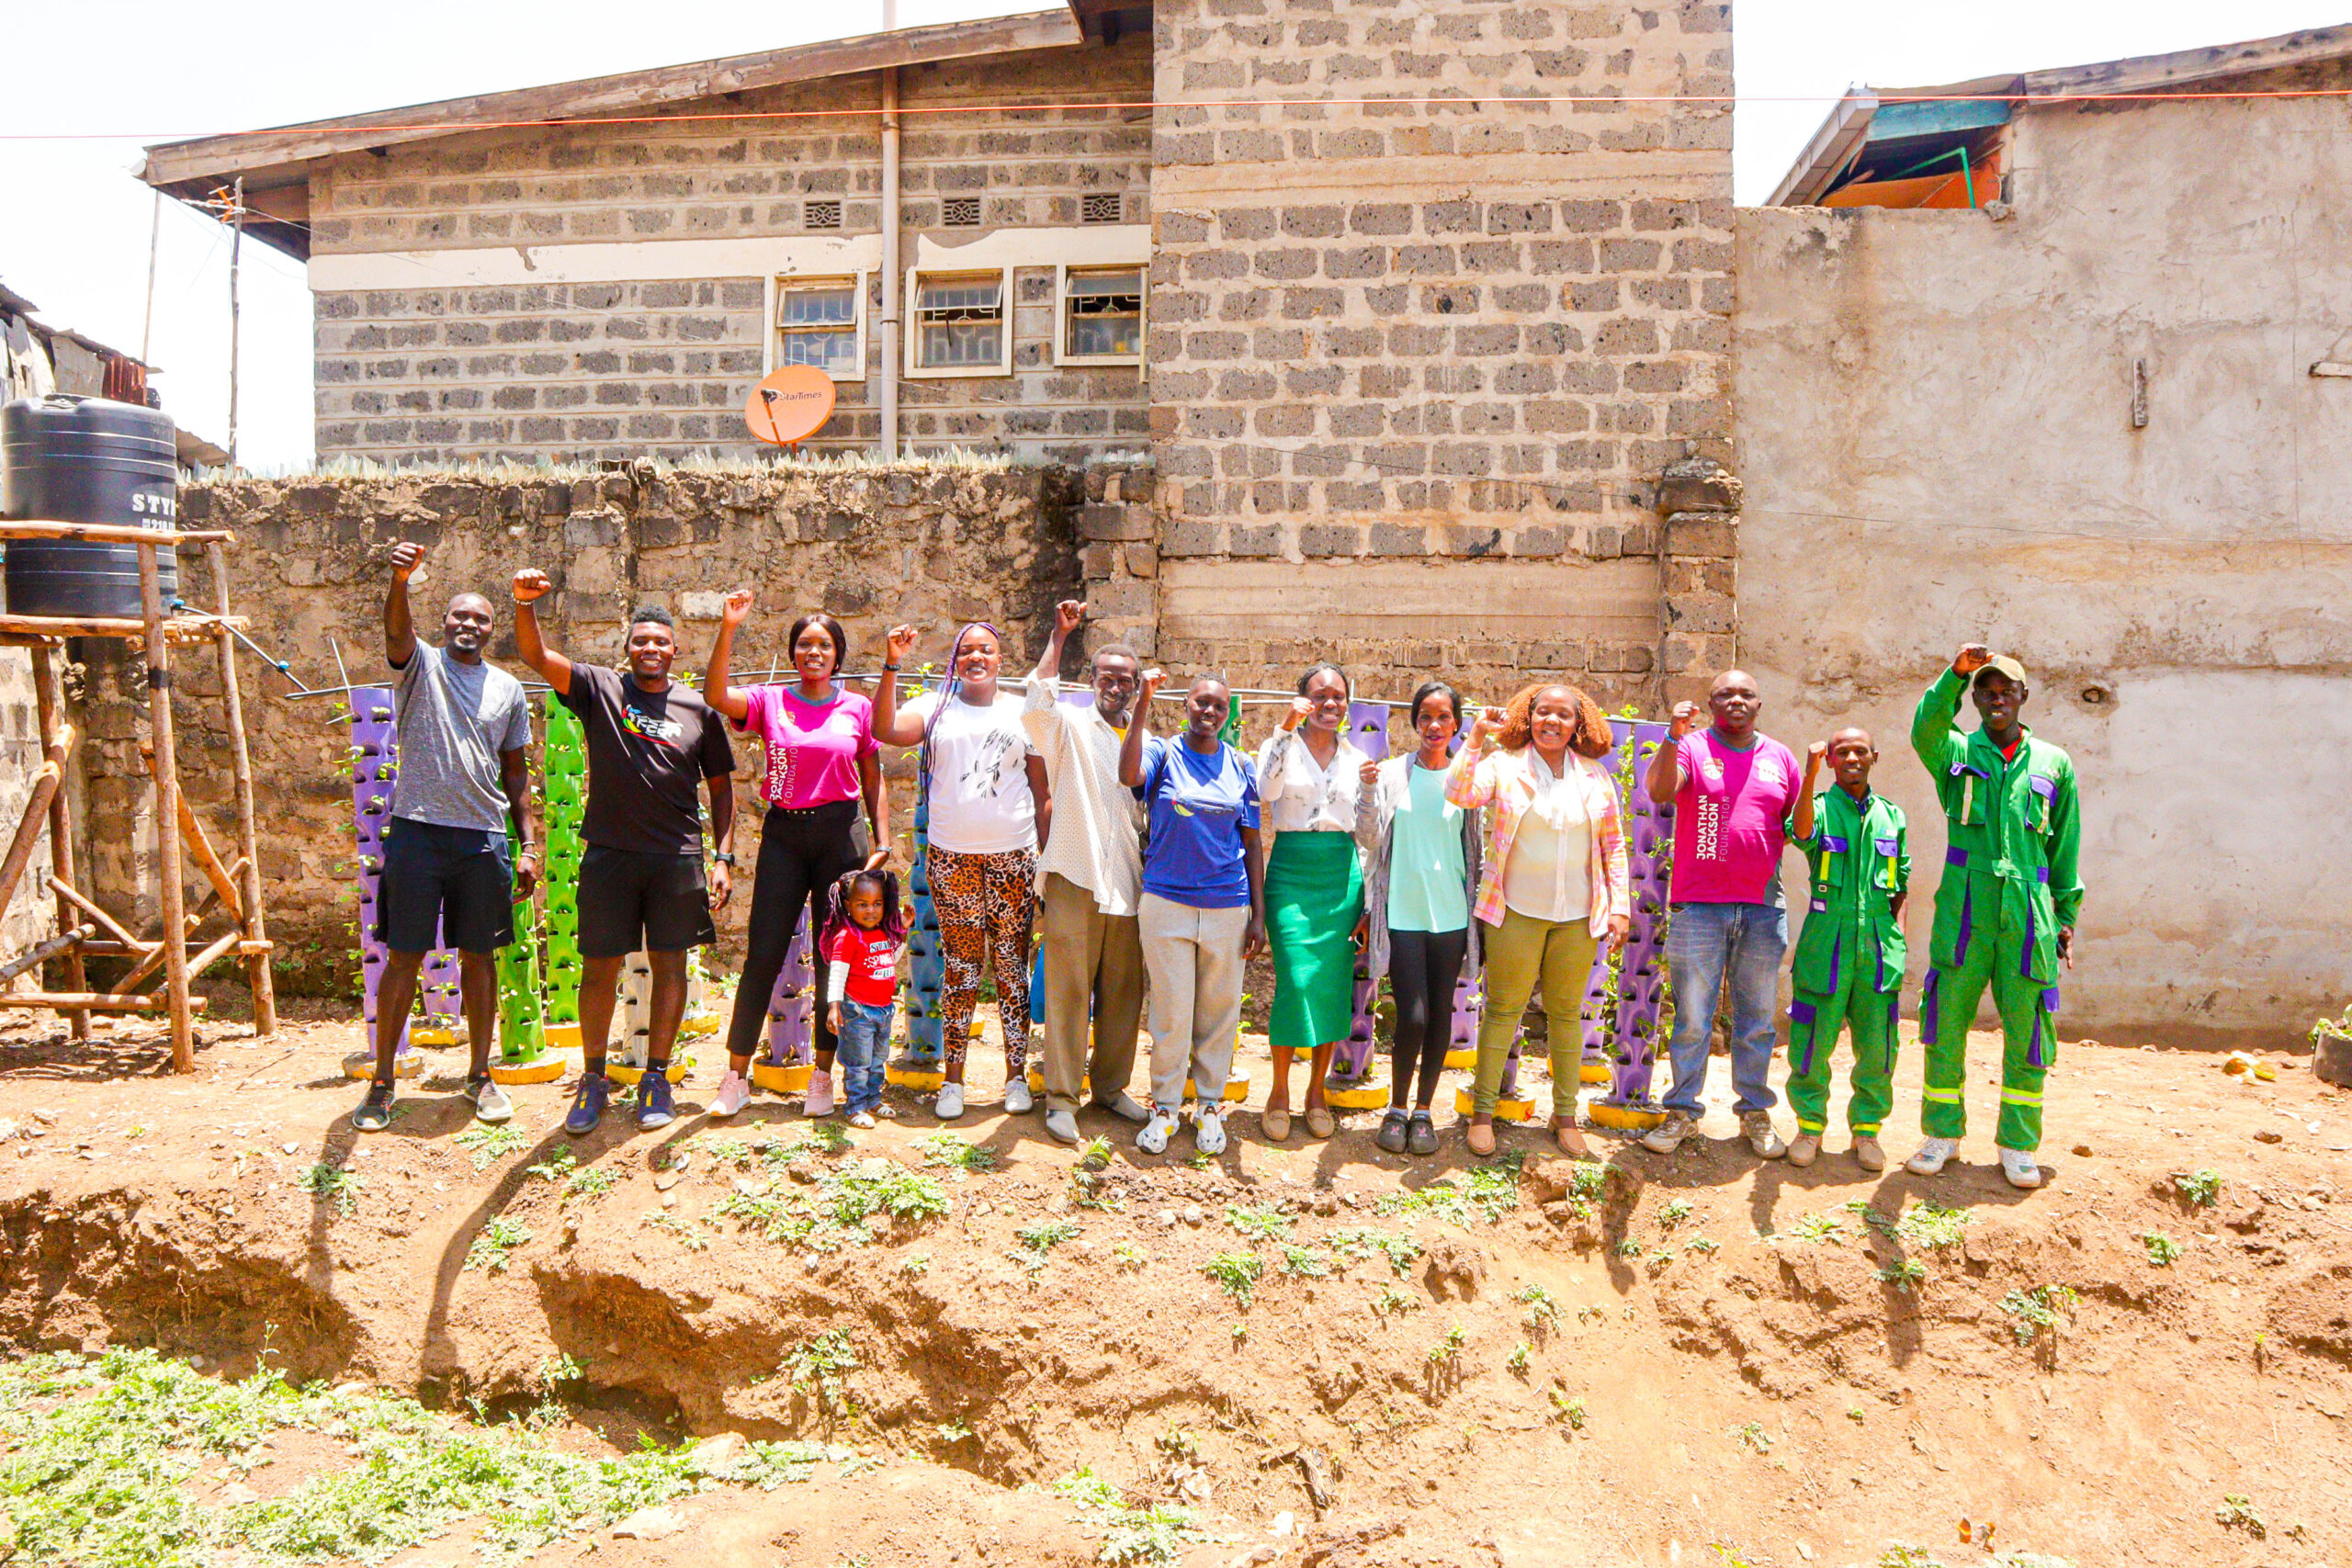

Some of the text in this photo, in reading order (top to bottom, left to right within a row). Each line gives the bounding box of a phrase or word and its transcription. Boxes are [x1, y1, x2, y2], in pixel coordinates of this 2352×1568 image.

[775, 748, 787, 800] JACKSON
[783, 740, 799, 806] FOUNDATION
[1696, 795, 1708, 860] JONATHAN
[1706, 803, 1719, 861] JACKSON
[1718, 795, 1731, 863] FOUNDATION
